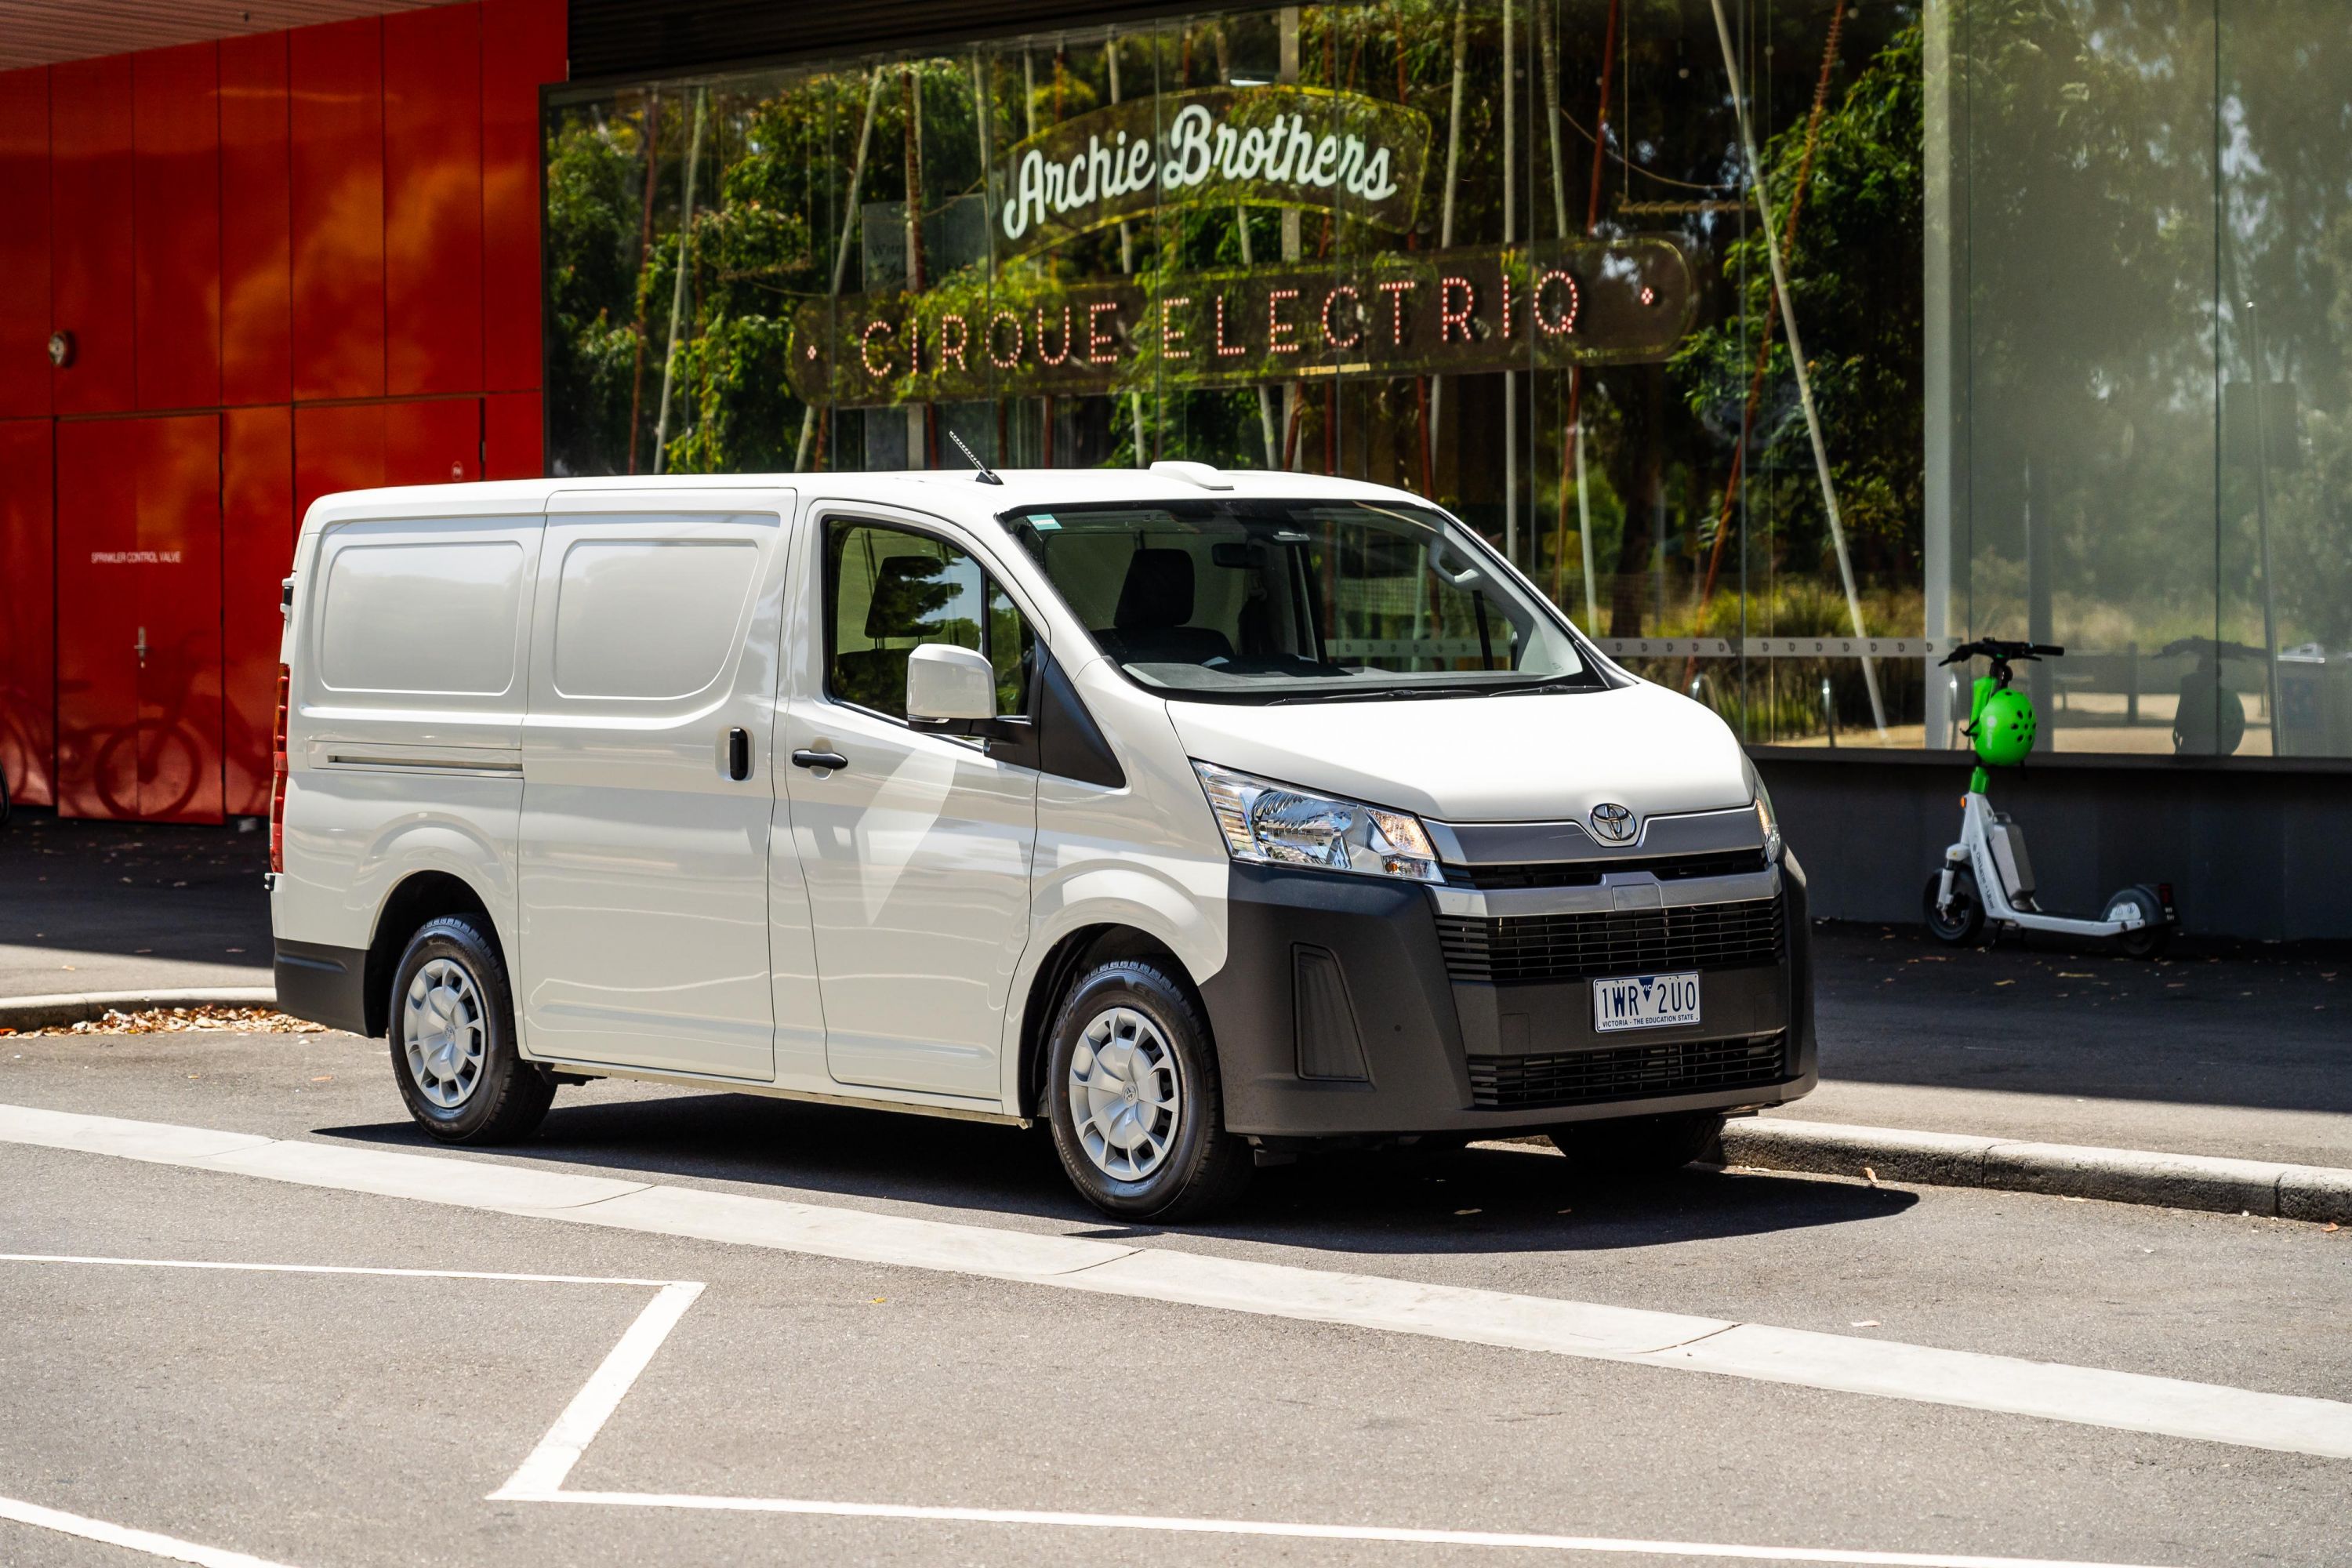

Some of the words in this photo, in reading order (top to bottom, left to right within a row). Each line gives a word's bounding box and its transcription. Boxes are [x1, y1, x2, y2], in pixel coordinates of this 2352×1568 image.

[1003, 129, 1157, 240] Archie
[1163, 103, 1397, 201] Brothers
[862, 303, 1119, 377] CIRQUE
[1163, 270, 1579, 358] ELECTRIQ
[91, 551, 125, 564] SPRINKLER
[127, 551, 158, 564] CONTROL
[159, 550, 181, 563] VALVE
[1602, 985, 1639, 1018] 1WR
[1646, 1015, 1676, 1024] EDUCATION
